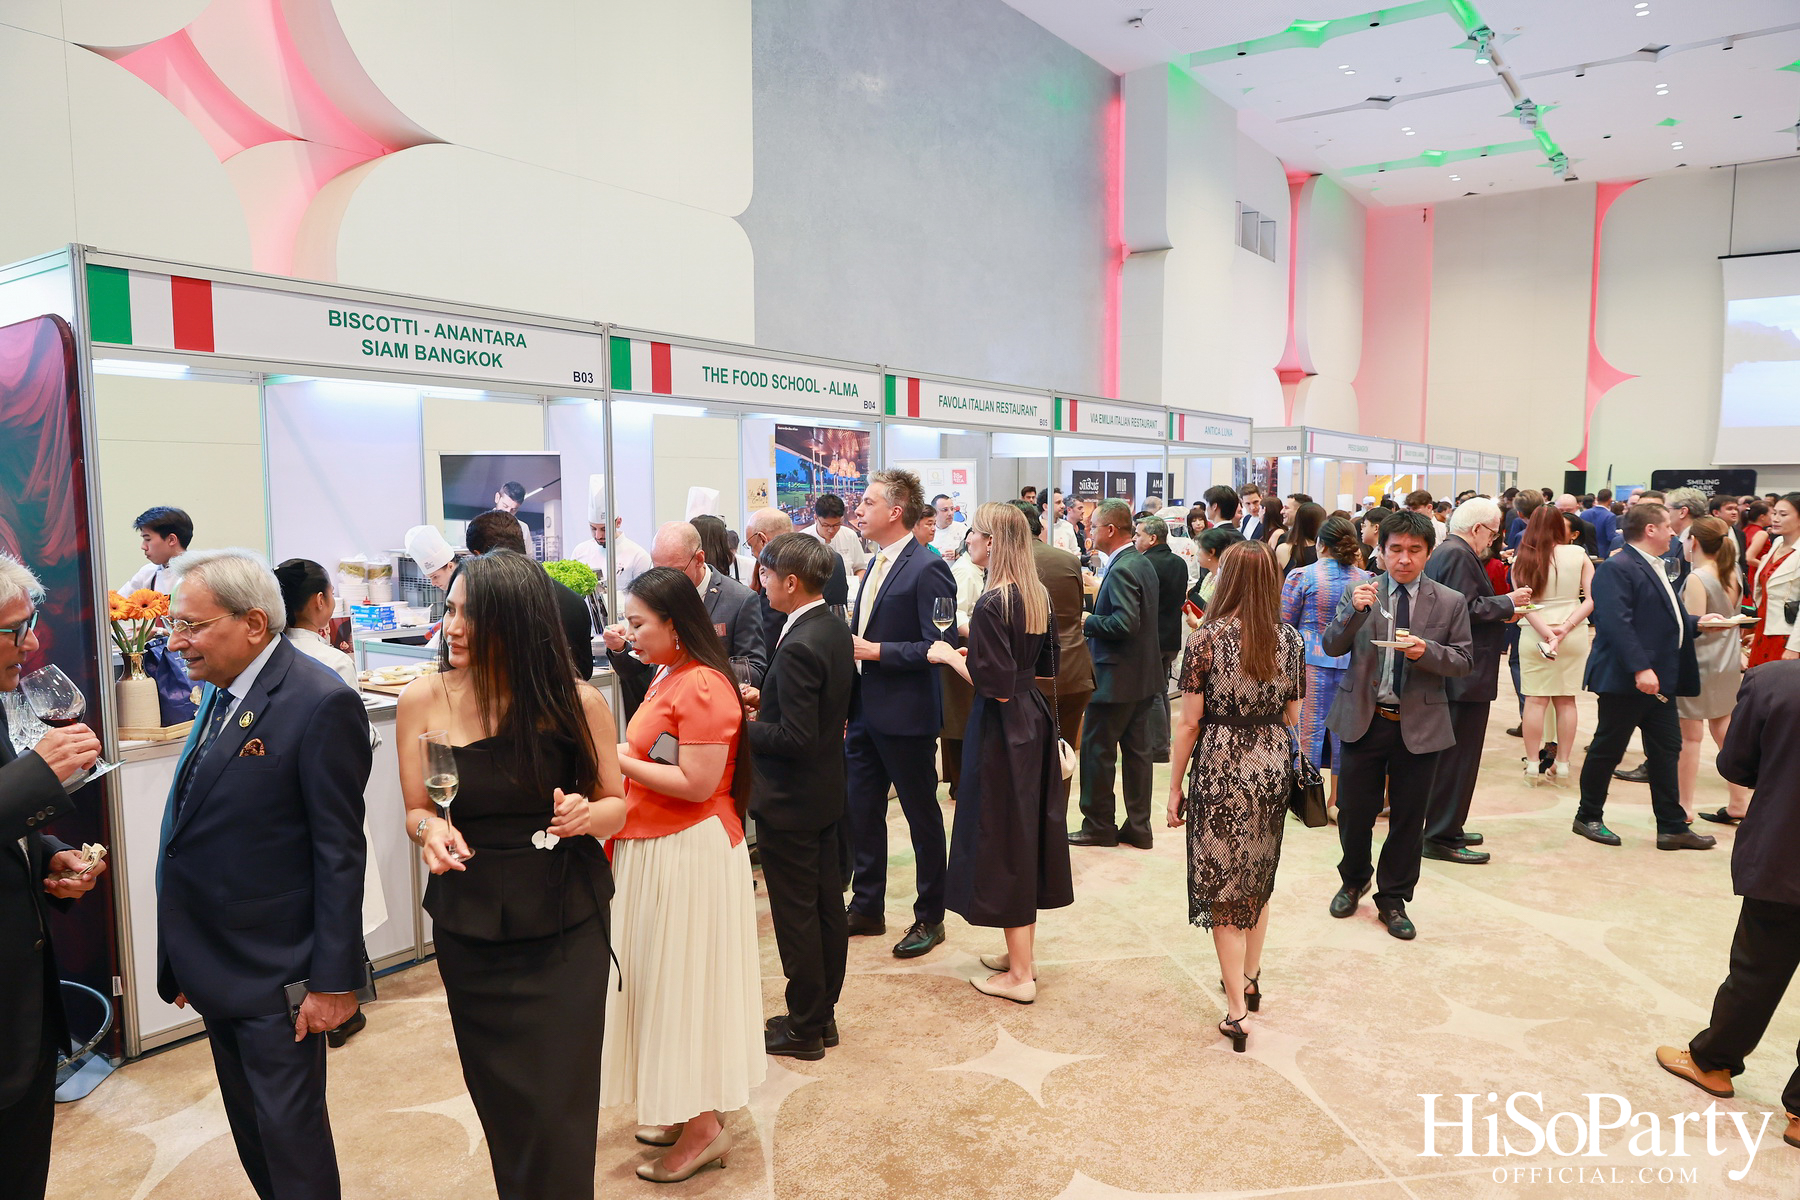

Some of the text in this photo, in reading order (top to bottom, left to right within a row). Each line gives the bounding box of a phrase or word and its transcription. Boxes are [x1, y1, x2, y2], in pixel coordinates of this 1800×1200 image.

[328, 309, 418, 335] BISCOTTI
[434, 323, 527, 348] ANANTARA
[361, 339, 503, 368] SIAM BANGKOK
[573, 371, 594, 384] B03
[702, 366, 729, 383] THE
[733, 369, 768, 388] FOOD
[771, 374, 820, 393] SCHOOL
[829, 381, 859, 397] ALMA
[863, 401, 876, 410] B04
[938, 395, 1038, 416] FAVOLA ITALIAN RESTAURANT
[1090, 413, 1158, 429] VIA EMILIA ITALIAN RESTAURANT
[1205, 426, 1233, 437] ANTICA LUNA
